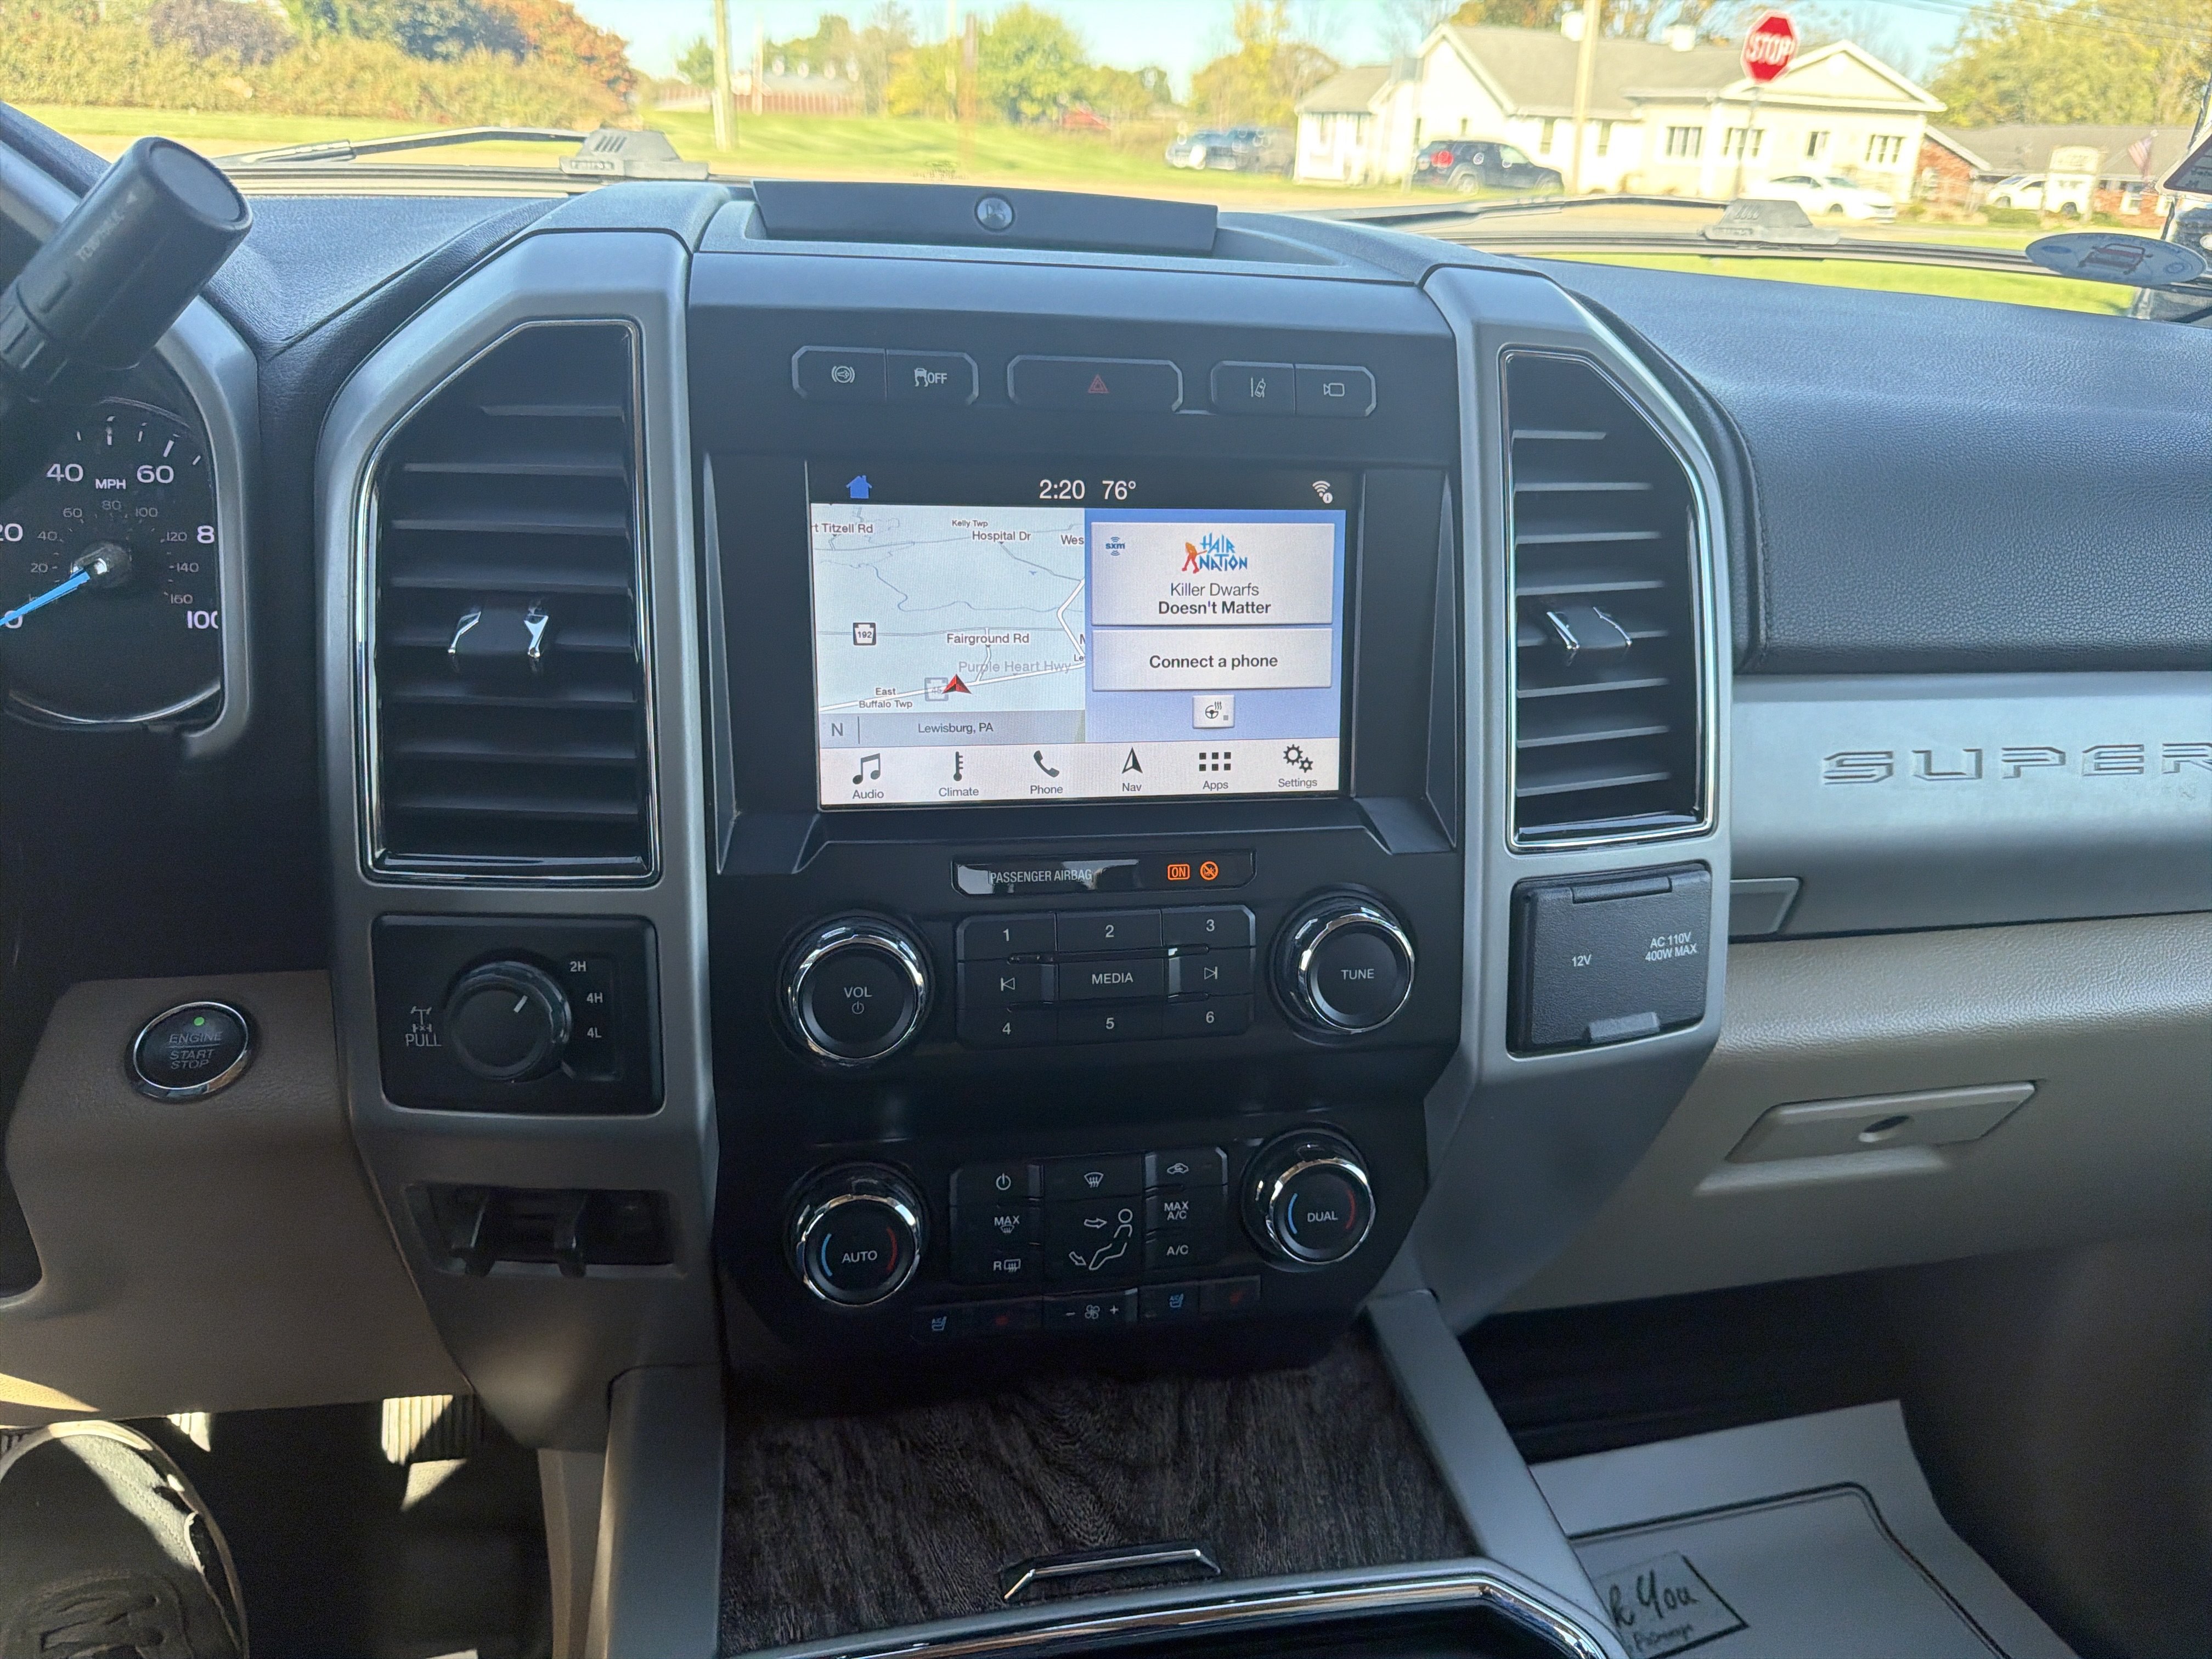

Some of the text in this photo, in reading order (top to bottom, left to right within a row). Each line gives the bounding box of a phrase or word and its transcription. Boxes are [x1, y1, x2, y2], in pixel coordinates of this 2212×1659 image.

[1746, 32, 1795, 66] STOP
[928, 373, 947, 383] OFF
[47, 464, 83, 482] 40
[137, 465, 174, 483] 60
[95, 479, 126, 490] MPH
[1040, 480, 1136, 500] 2:20 76°
[101, 500, 121, 510] 80
[63, 508, 82, 518] 60
[136, 507, 158, 518] 100
[821, 523, 854, 533] Titzell
[857, 523, 873, 533] Rd
[952, 520, 970, 528] Kelly
[0, 523, 23, 542] 0
[37, 531, 57, 541] 40
[167, 531, 187, 541] 120
[972, 531, 1031, 542] Hospital Dr
[1061, 535, 1085, 545] Wes
[1200, 533, 1235, 554] HAIR
[31, 563, 48, 573] 20
[177, 562, 199, 573] 140
[1199, 554, 1248, 571] NATION
[1171, 583, 1259, 596] Killer Dwarfs
[170, 594, 193, 605] 160
[1159, 601, 1271, 614] Doesn't Matter
[947, 633, 1029, 645] Fairground Rd
[959, 661, 1071, 674] Purple Heart Hwy
[1149, 654, 1278, 670] Connect a phone
[859, 700, 912, 709] Buffalo Twp
[832, 724, 843, 736] N
[918, 723, 994, 734] Lewisburg, PA
[1824, 743, 2212, 785] SUPER
[1122, 783, 1142, 792] Nav
[1203, 780, 1229, 791] Apps
[1278, 777, 1317, 789] Settings
[853, 789, 884, 799] Audio
[939, 787, 979, 797] Climate
[1030, 785, 1063, 794] Phone
[990, 868, 1092, 884] PASSENGER AIRBAG
[1171, 867, 1186, 877] ON
[1206, 919, 1215, 932] 3
[1003, 929, 1009, 941] 1
[1105, 925, 1114, 938] 2
[1650, 932, 1691, 949] AC 110V
[1645, 943, 1697, 962] 400W MAX
[1572, 954, 1592, 967] 12V
[570, 961, 586, 972] 2H
[1092, 973, 1133, 985] MEDIA
[1341, 968, 1374, 980] TUNE
[844, 986, 872, 998] VOL
[586, 993, 603, 1003] 4H
[1106, 1018, 1114, 1029] 5
[1206, 1012, 1215, 1024] 6
[587, 1028, 602, 1039] 4L
[1002, 1023, 1011, 1034] 4
[168, 1031, 223, 1045] ENGINE
[405, 1034, 442, 1047] PULL
[170, 1048, 215, 1060] START
[171, 1059, 209, 1070] STOP
[1164, 1201, 1189, 1211] MAX
[994, 1215, 1020, 1225] MAX
[1167, 1211, 1187, 1221] A/C
[1307, 1211, 1338, 1223] DUAL
[1166, 1245, 1188, 1256] A/C
[842, 1250, 878, 1263] AUTO
[994, 1261, 1002, 1271] R
